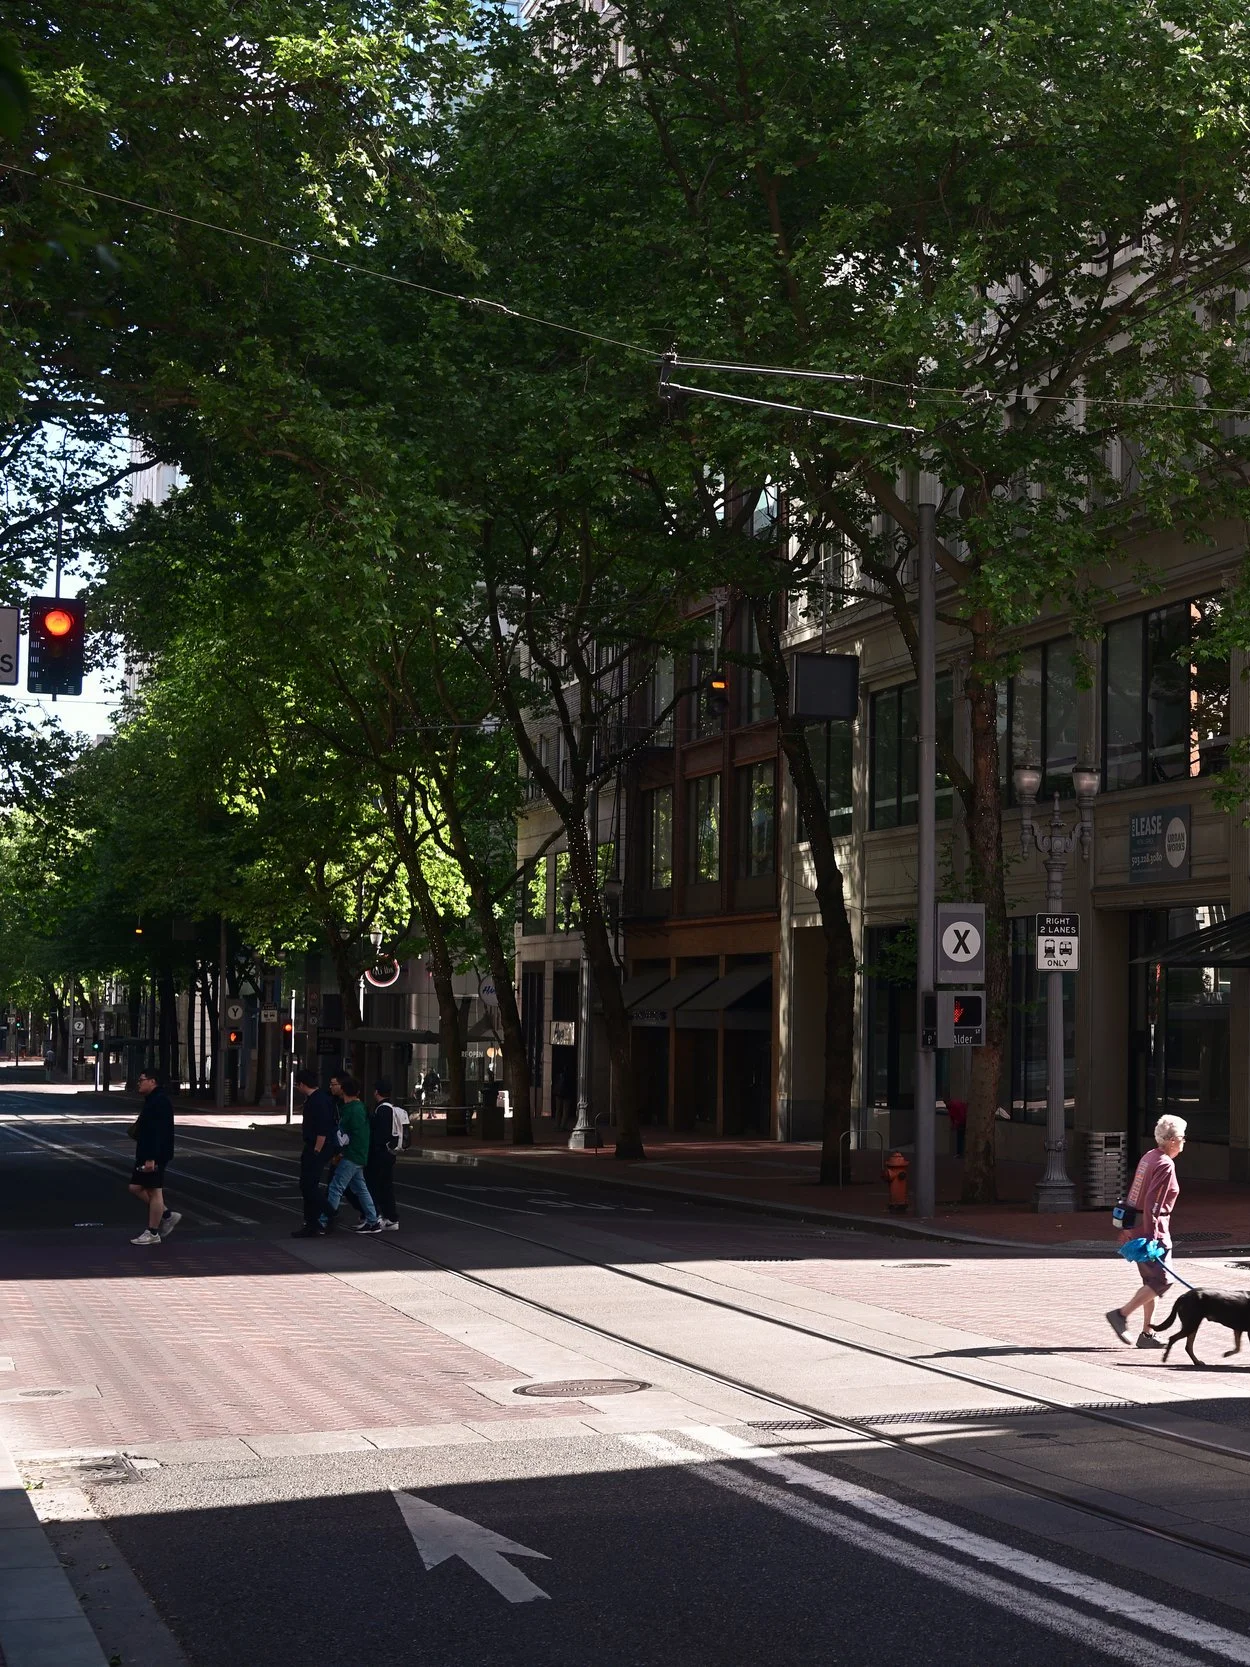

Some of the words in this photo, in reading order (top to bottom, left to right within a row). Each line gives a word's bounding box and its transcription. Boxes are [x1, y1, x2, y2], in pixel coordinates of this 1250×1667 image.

[1135, 815, 1162, 837] LEASE
[1167, 832, 1185, 843] URBAN
[1167, 842, 1185, 852] WORKS
[1045, 917, 1070, 925] RIGHT
[1040, 926, 1045, 934] 2
[1048, 926, 1076, 934] LANES
[952, 929, 971, 954] X
[232, 1008, 239, 1017] Y
[954, 1034, 973, 1044] Alder
